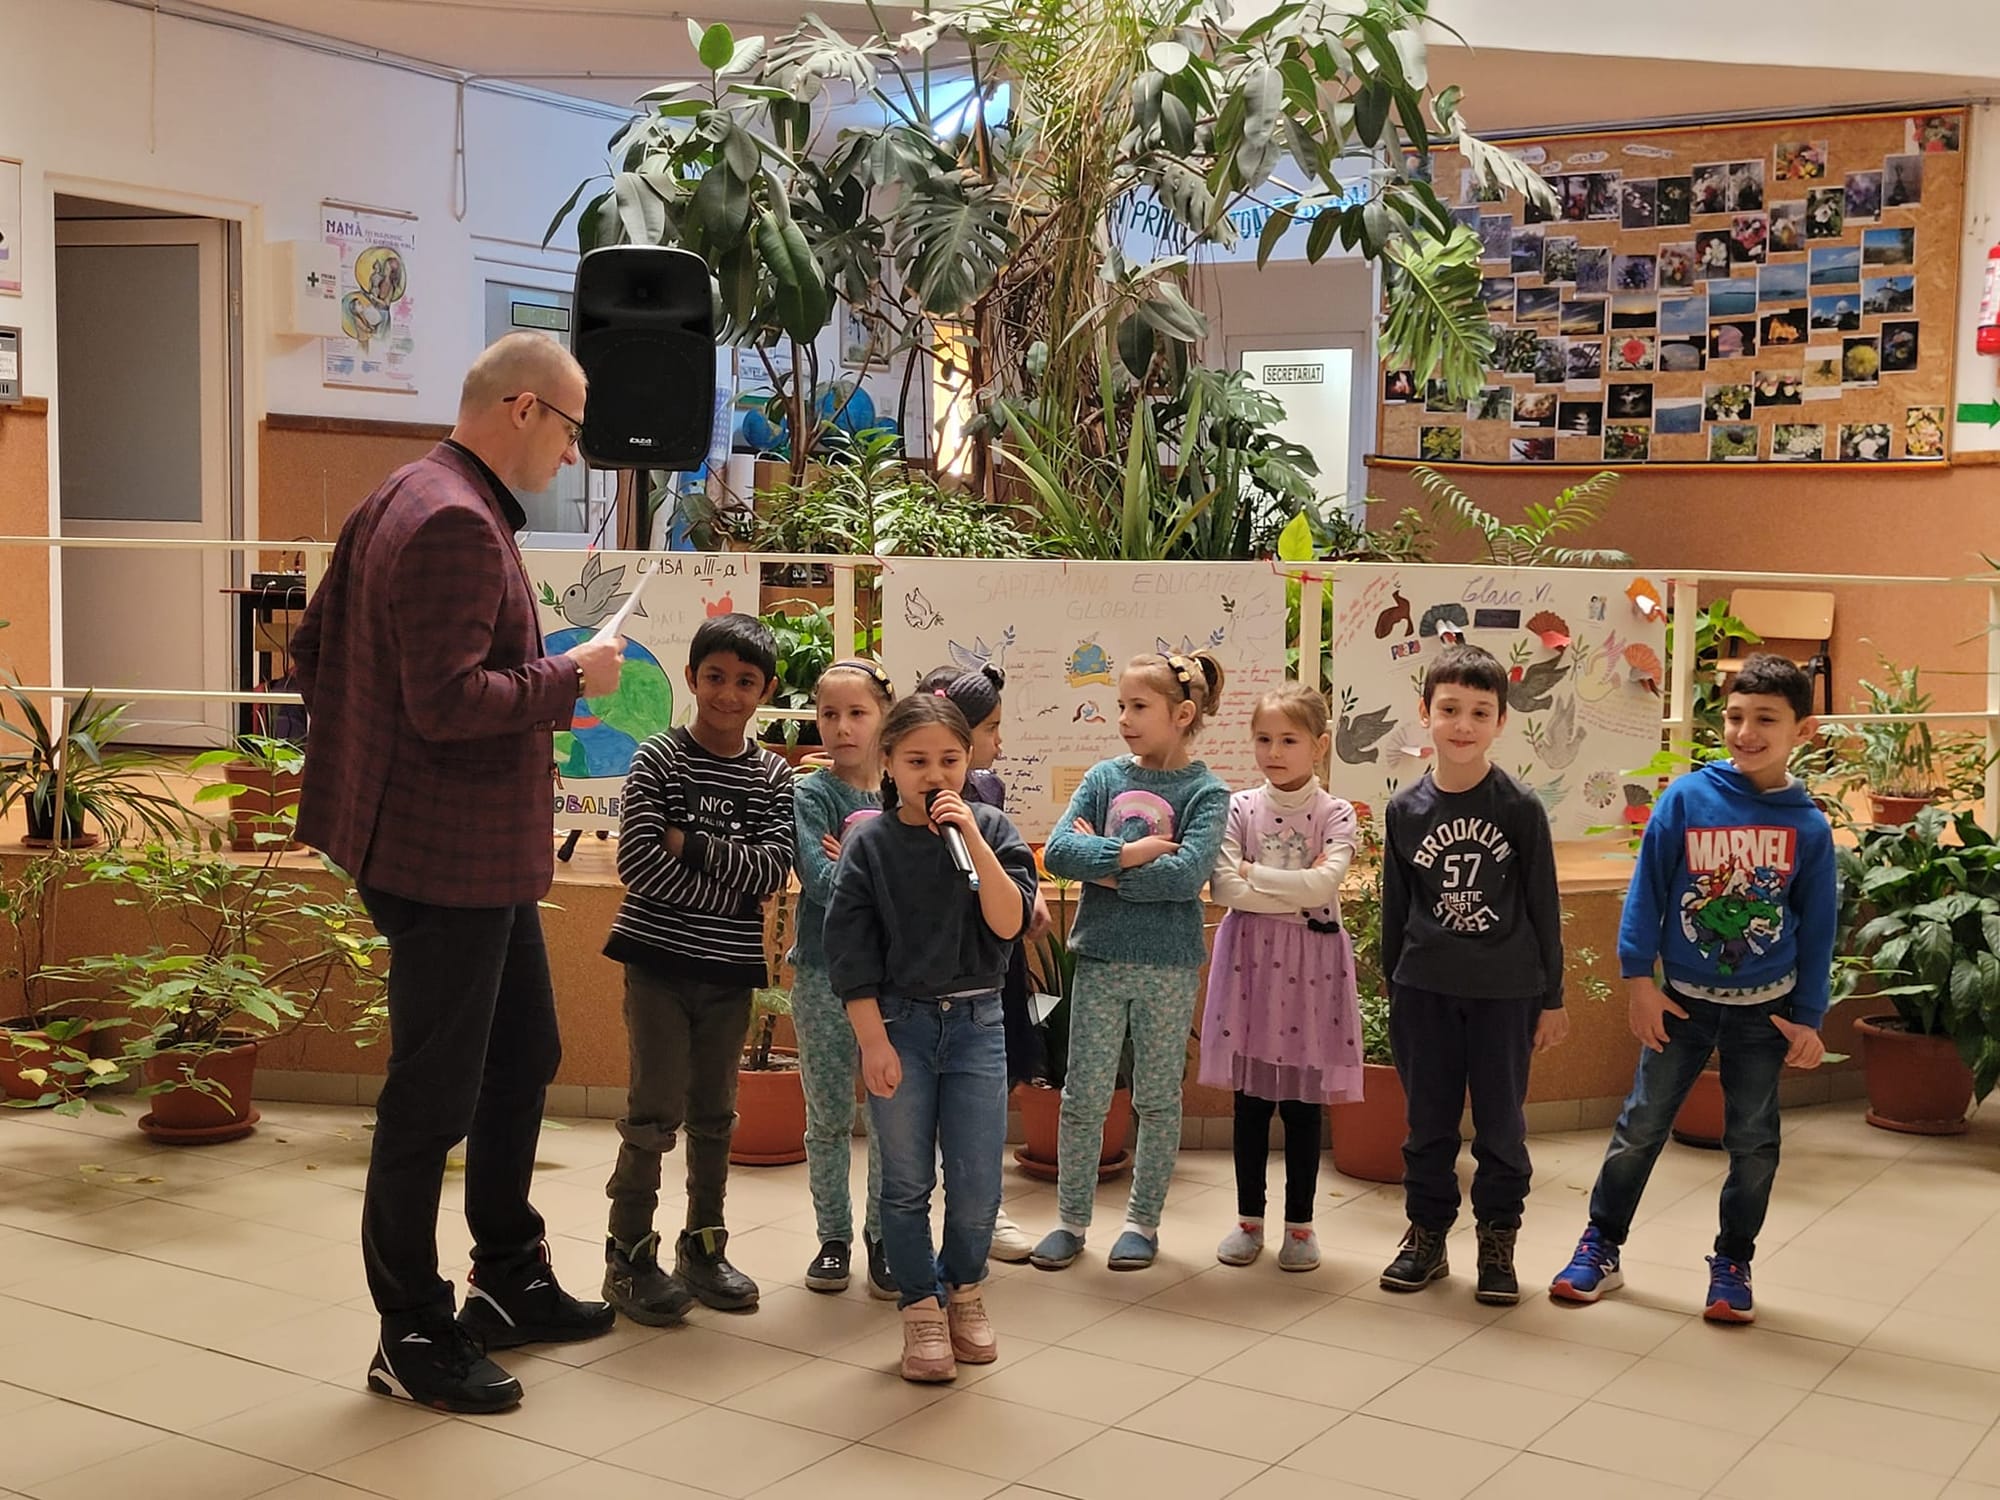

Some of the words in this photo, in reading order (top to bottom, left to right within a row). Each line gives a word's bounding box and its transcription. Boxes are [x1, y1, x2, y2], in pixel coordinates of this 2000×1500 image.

[1266, 367, 1321, 382] SECRETARIAT
[636, 556, 683, 576] CASA
[1065, 599, 1169, 621] GLOBALE
[553, 794, 620, 817] OBALE
[699, 795, 735, 816] NYC
[1412, 817, 1512, 869] BROOKLYN
[1687, 828, 1790, 872] MARVEL
[1442, 852, 1482, 888] 57
[1432, 900, 1500, 932] STREET
